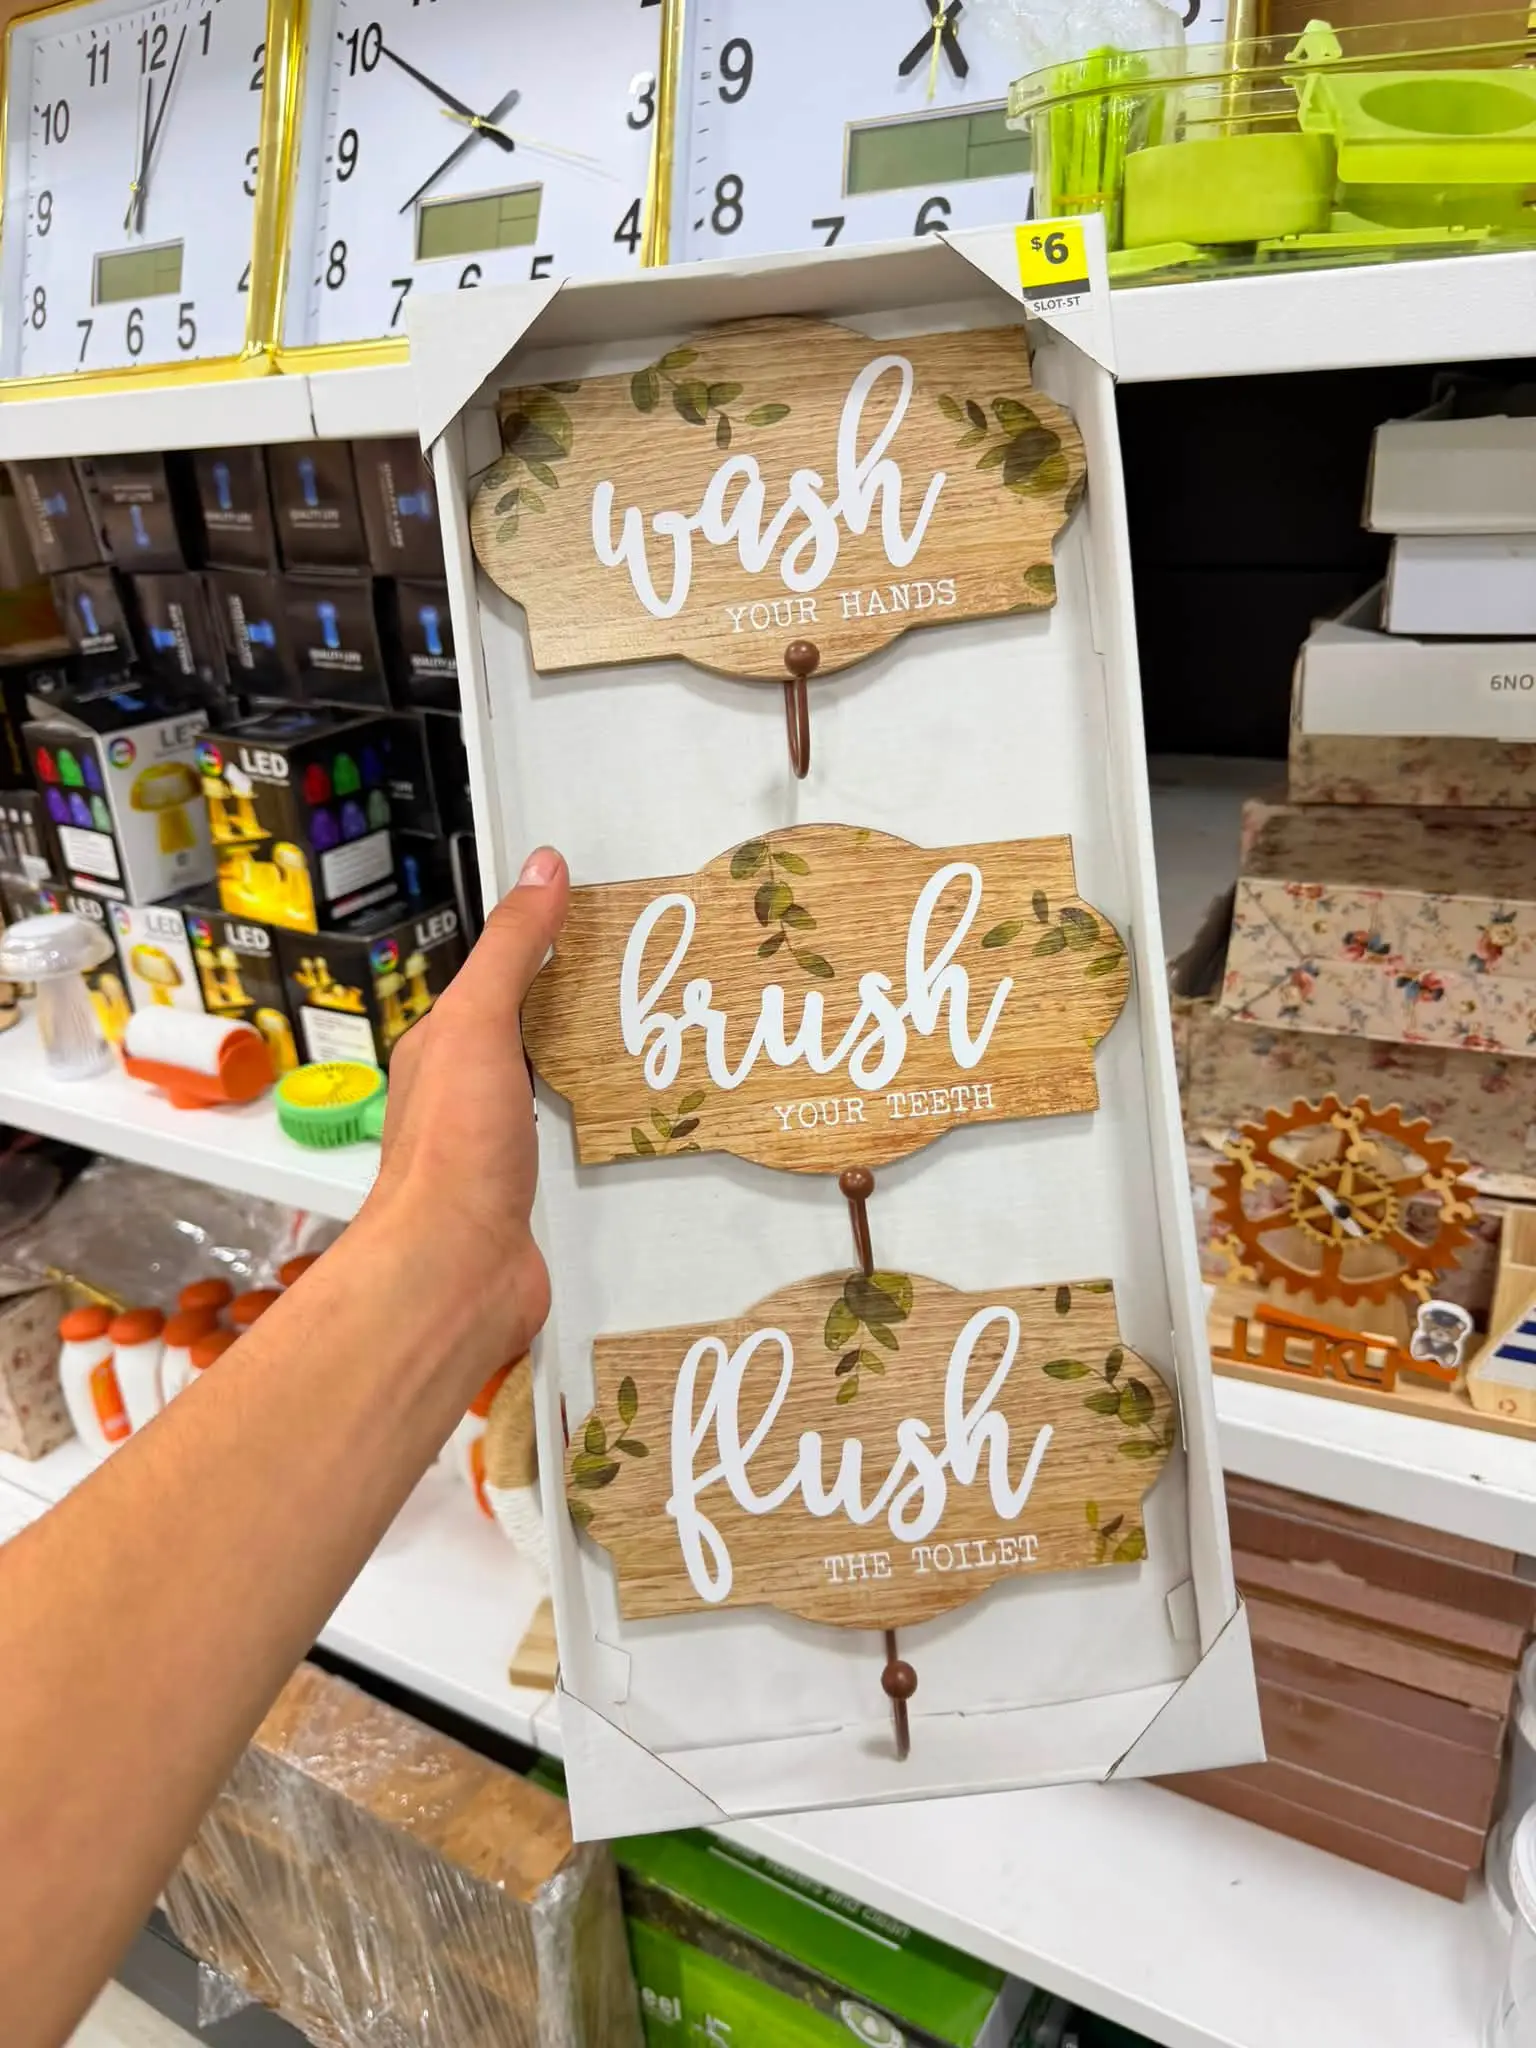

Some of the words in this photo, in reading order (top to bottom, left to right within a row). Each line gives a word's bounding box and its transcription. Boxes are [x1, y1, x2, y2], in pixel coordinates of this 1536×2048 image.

[141, 24, 168, 74] 12
[199, 12, 211, 55] 1
[346, 22, 382, 77] 10
[87, 43, 111, 87] 11
[718, 37, 754, 105] 9
[41, 101, 70, 144] 10
[627, 71, 656, 130] 3
[337, 129, 359, 181] 9
[37, 190, 53, 236] 9
[614, 198, 642, 253] 4
[712, 174, 744, 235] 8
[326, 240, 347, 290] 8
[1030, 231, 1070, 265] $6
[31, 287, 47, 329] 8
[178, 302, 196, 350] 5
[389, 278, 414, 328] 7
[76, 320, 94, 362] 7
[127, 308, 144, 356] 6
[592, 355, 946, 618] wash
[725, 597, 821, 634] YOUR
[840, 579, 958, 620] HANDS
[1490, 673, 1535, 691] 6NO
[238, 747, 289, 778] LED
[68, 896, 104, 921] LED
[145, 913, 183, 938] LED
[415, 909, 458, 946] LED
[224, 922, 271, 950] LED
[620, 862, 1014, 1090] brush
[774, 1097, 866, 1131] YOUR
[886, 1084, 995, 1120] TEETH
[666, 1306, 1054, 1602] flush
[824, 1551, 892, 1584] THE
[911, 1534, 1039, 1575] TOILET
